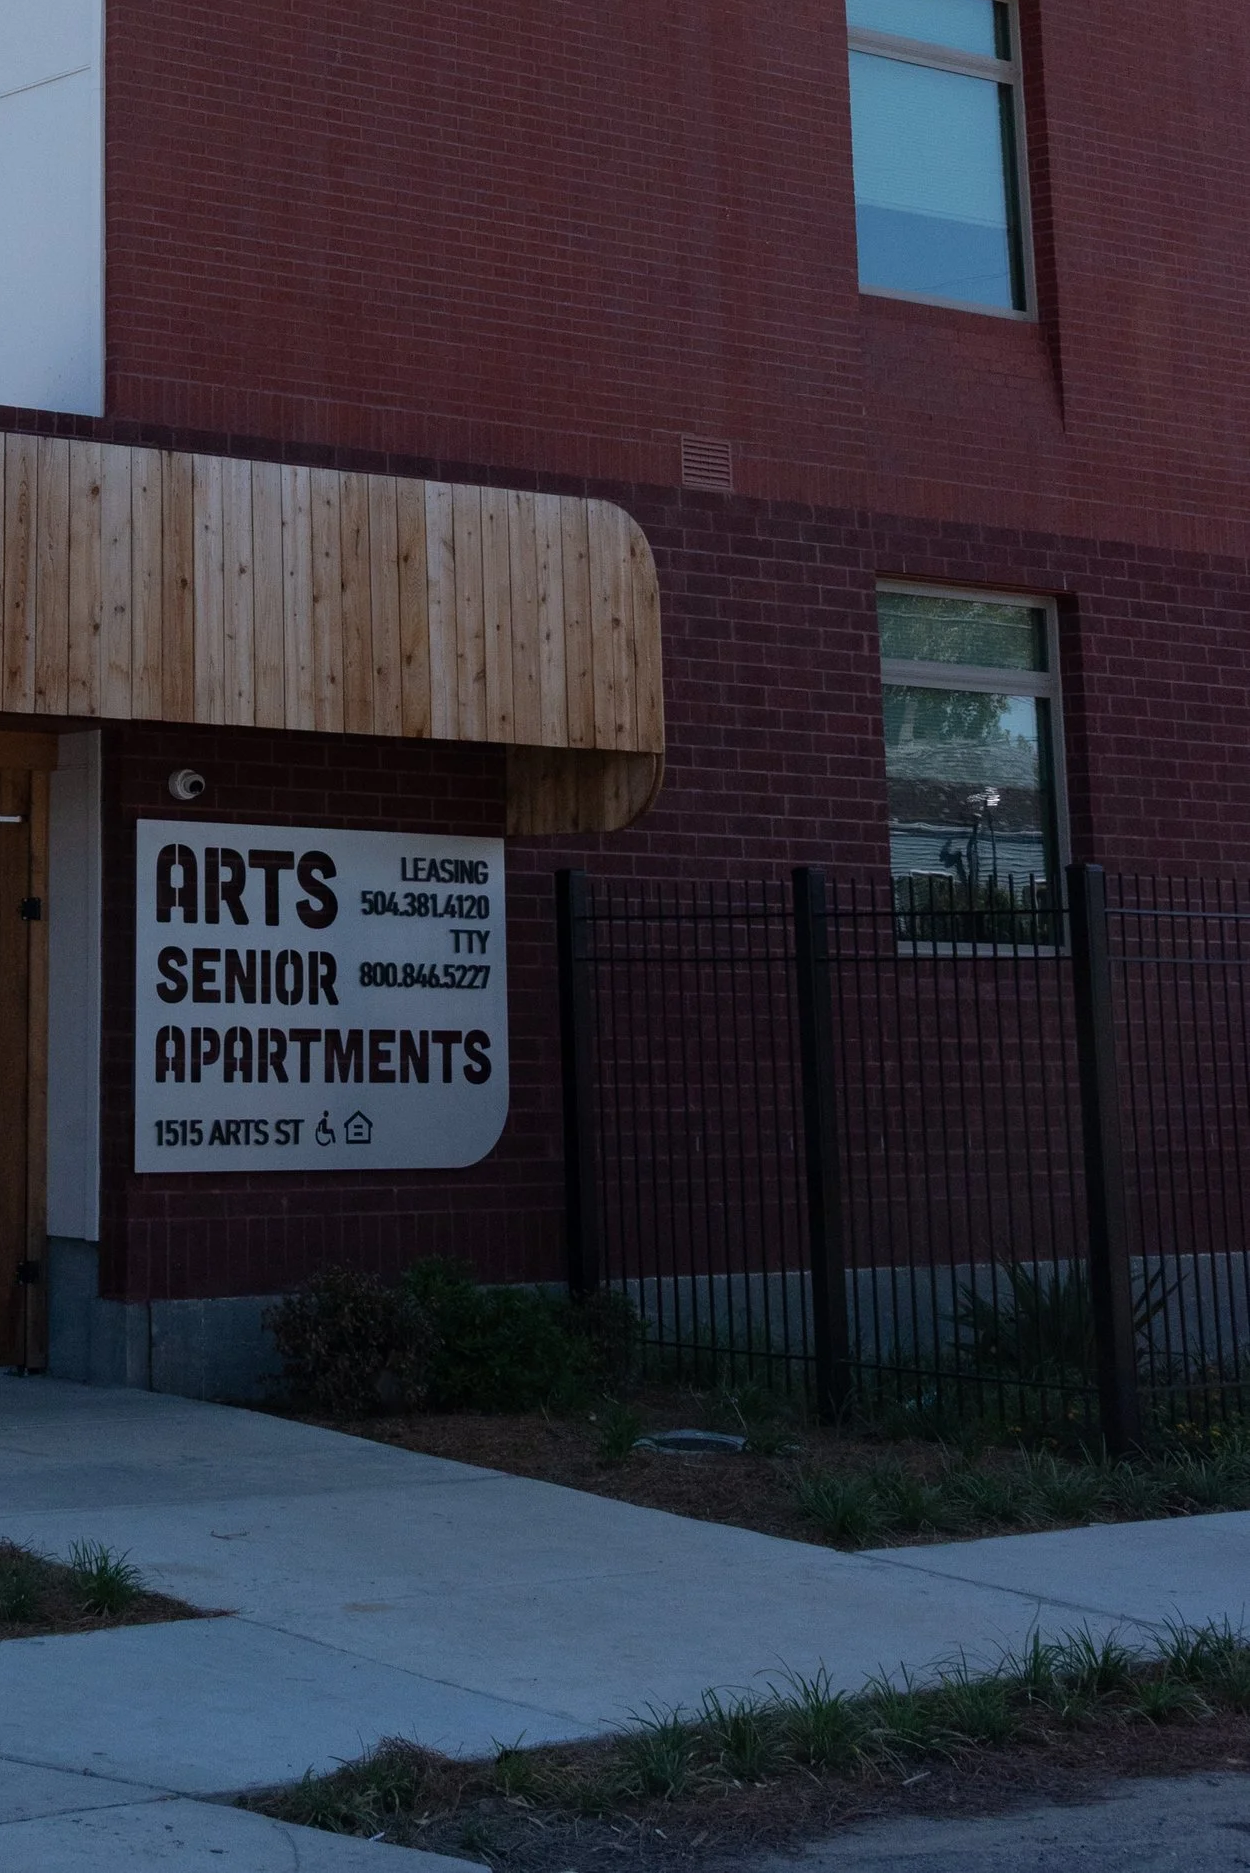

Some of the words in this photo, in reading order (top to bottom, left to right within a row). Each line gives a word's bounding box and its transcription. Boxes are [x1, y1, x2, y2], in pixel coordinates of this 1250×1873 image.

[400, 856, 489, 885] LEASING
[155, 843, 339, 929] ARTS
[360, 890, 490, 920] 504.381.4120
[450, 929, 490, 954] TTY
[155, 945, 339, 1006] SENIOR
[359, 961, 491, 990] 800.846.5227
[154, 1024, 493, 1085] APARTMENTS
[154, 1119, 204, 1147] 1515
[208, 1119, 270, 1146] ARTS
[274, 1119, 305, 1146] ST
